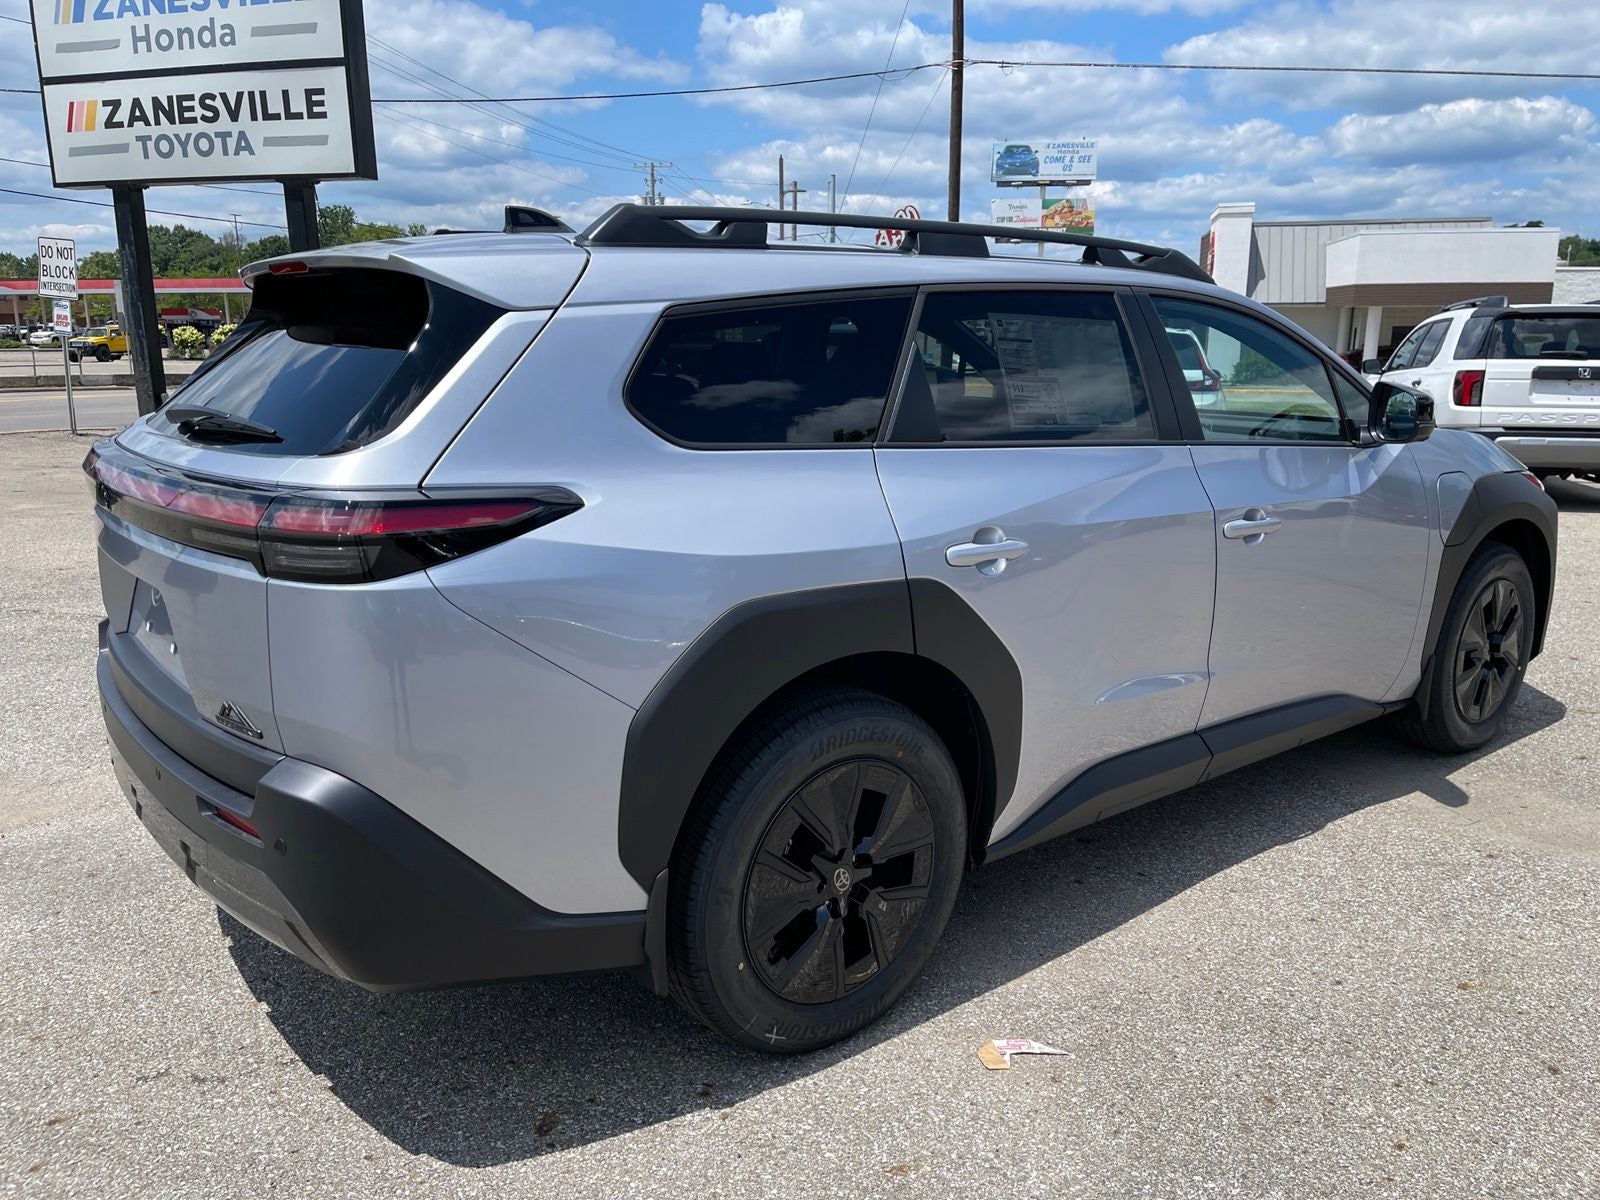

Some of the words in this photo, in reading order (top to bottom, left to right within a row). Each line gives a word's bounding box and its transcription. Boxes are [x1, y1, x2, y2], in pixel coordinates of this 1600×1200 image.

[130, 17, 237, 54] Honda
[102, 87, 328, 130] ZANESVILLE
[135, 130, 256, 160] TOYOTA
[1043, 155, 1066, 164] COME
[1069, 155, 1075, 164] &
[1078, 155, 1092, 164] SEE
[1062, 164, 1073, 172] US
[41, 245, 54, 259] DO
[56, 246, 74, 260] NOT
[42, 264, 75, 280] BLOCK
[41, 281, 76, 293] INTERSECTION
[55, 320, 70, 328] STOP
[810, 726, 928, 761] BRIDGESTONE
